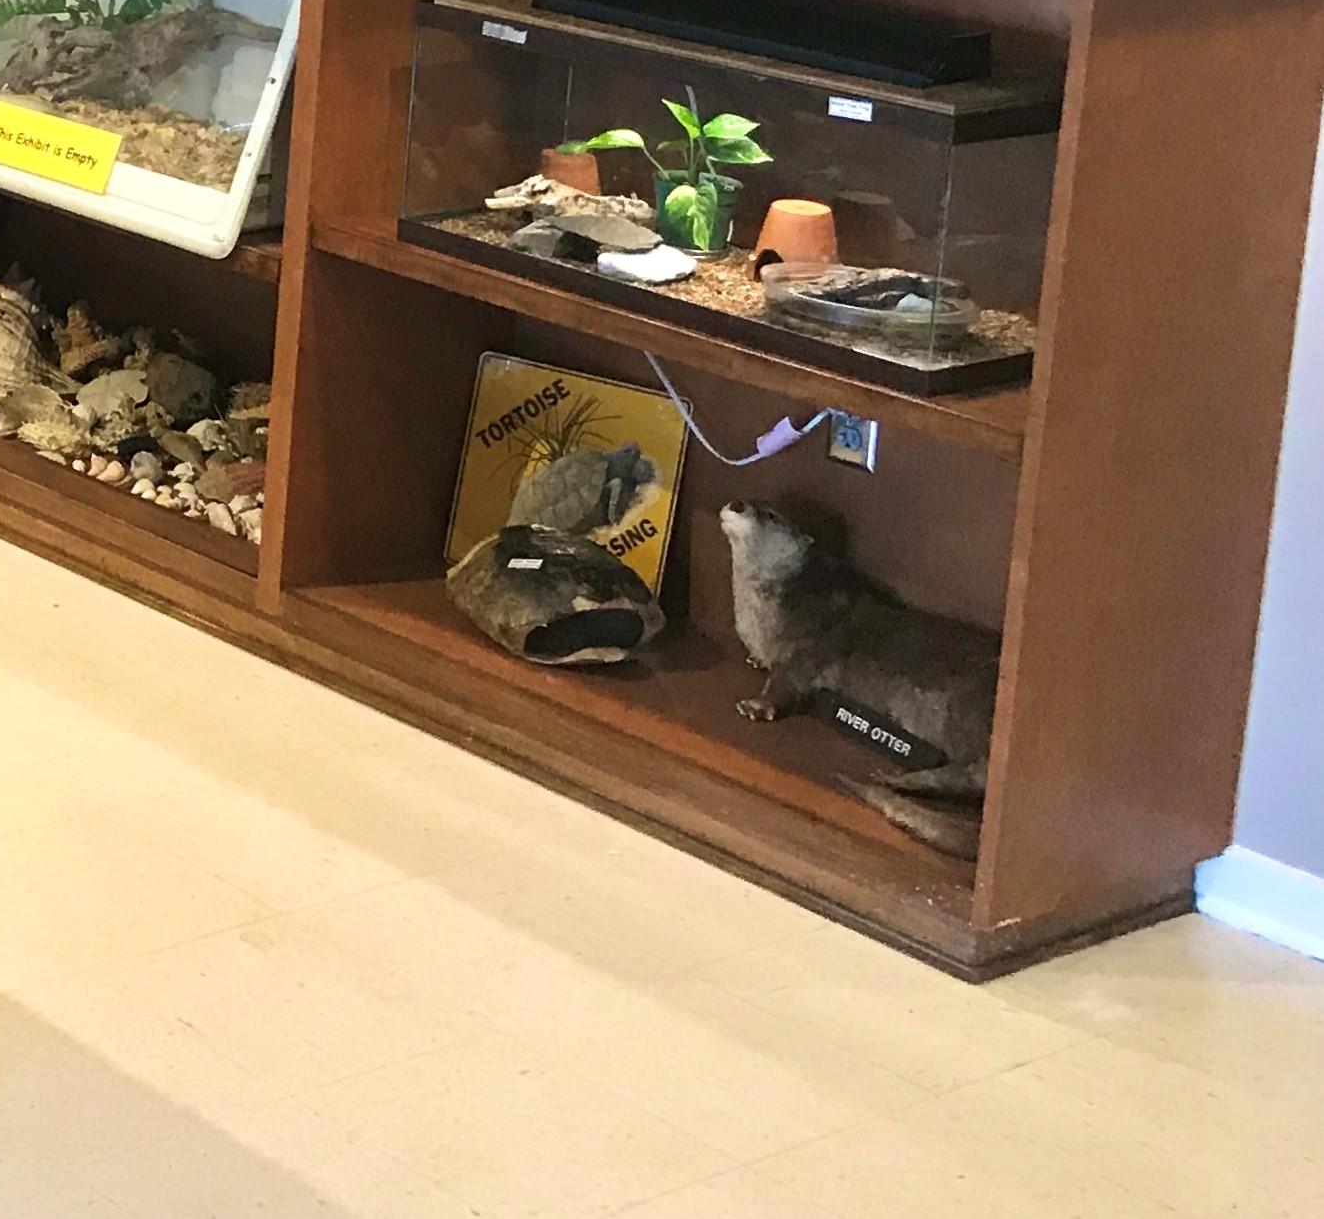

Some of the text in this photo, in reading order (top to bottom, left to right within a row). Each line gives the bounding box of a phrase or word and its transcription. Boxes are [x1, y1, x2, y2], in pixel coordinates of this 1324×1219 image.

[15, 132, 51, 152] Exhibit
[53, 145, 63, 157] is
[65, 147, 98, 169] Empty
[474, 378, 572, 449] TORTOISE
[835, 707, 913, 757] RIVER OTTER
